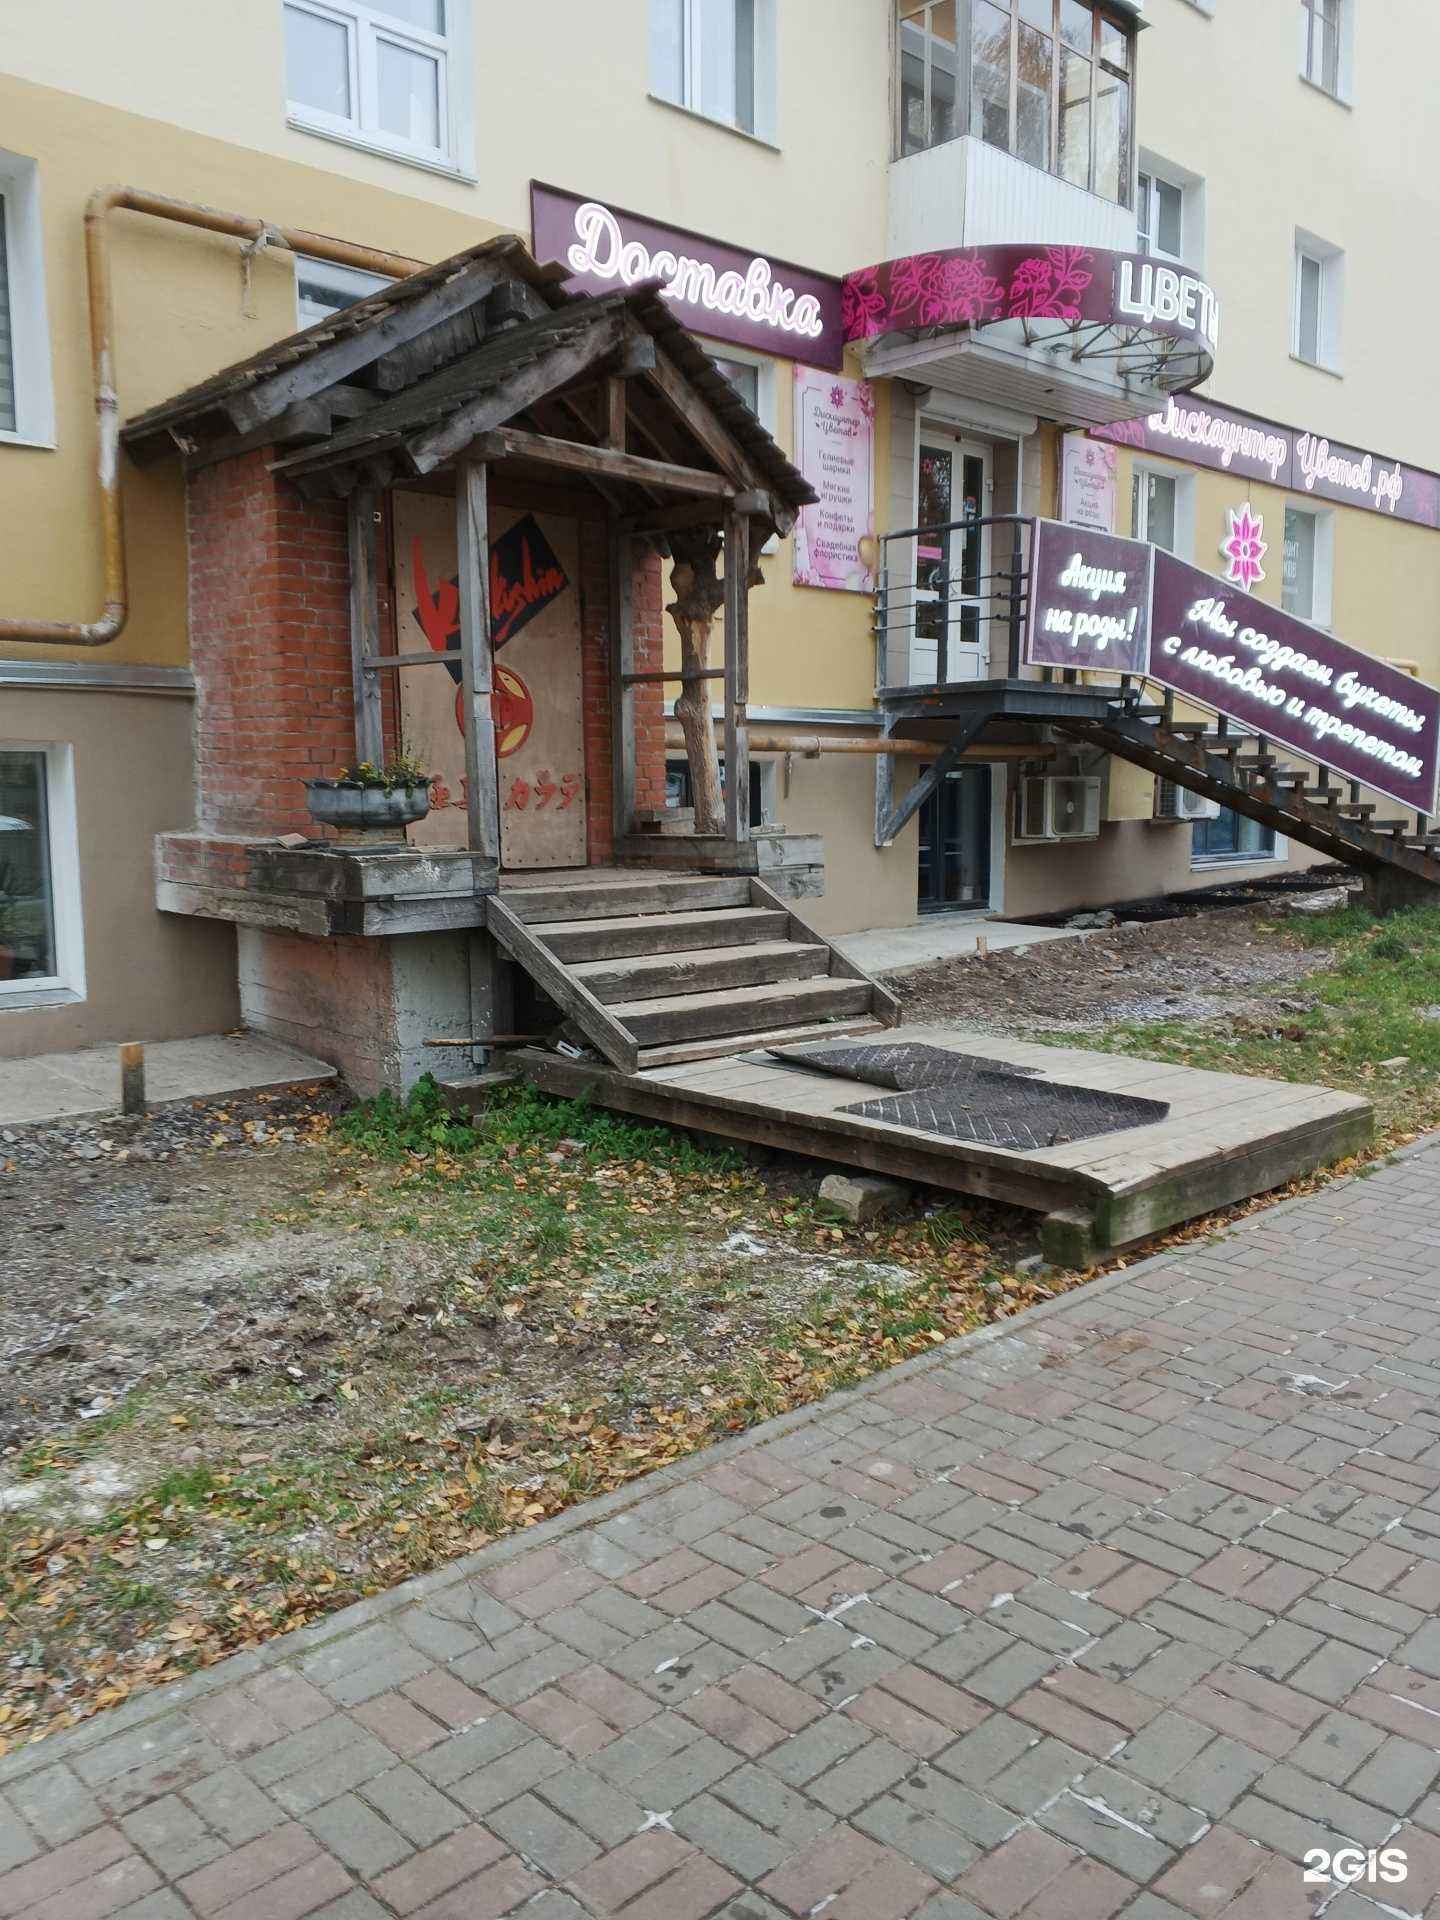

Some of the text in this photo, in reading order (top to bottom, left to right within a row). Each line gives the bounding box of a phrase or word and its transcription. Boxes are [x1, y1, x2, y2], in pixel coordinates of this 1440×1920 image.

[567, 202, 824, 338] Доставка
[819, 509, 853, 523] Конфеты
[823, 521, 855, 533] подарки
[1061, 553, 1127, 601] Акция
[1045, 608, 1073, 634] на
[1188, 598, 1426, 733] Мы создаем букеты
[1163, 636, 1424, 777] с любовью и трепетом
